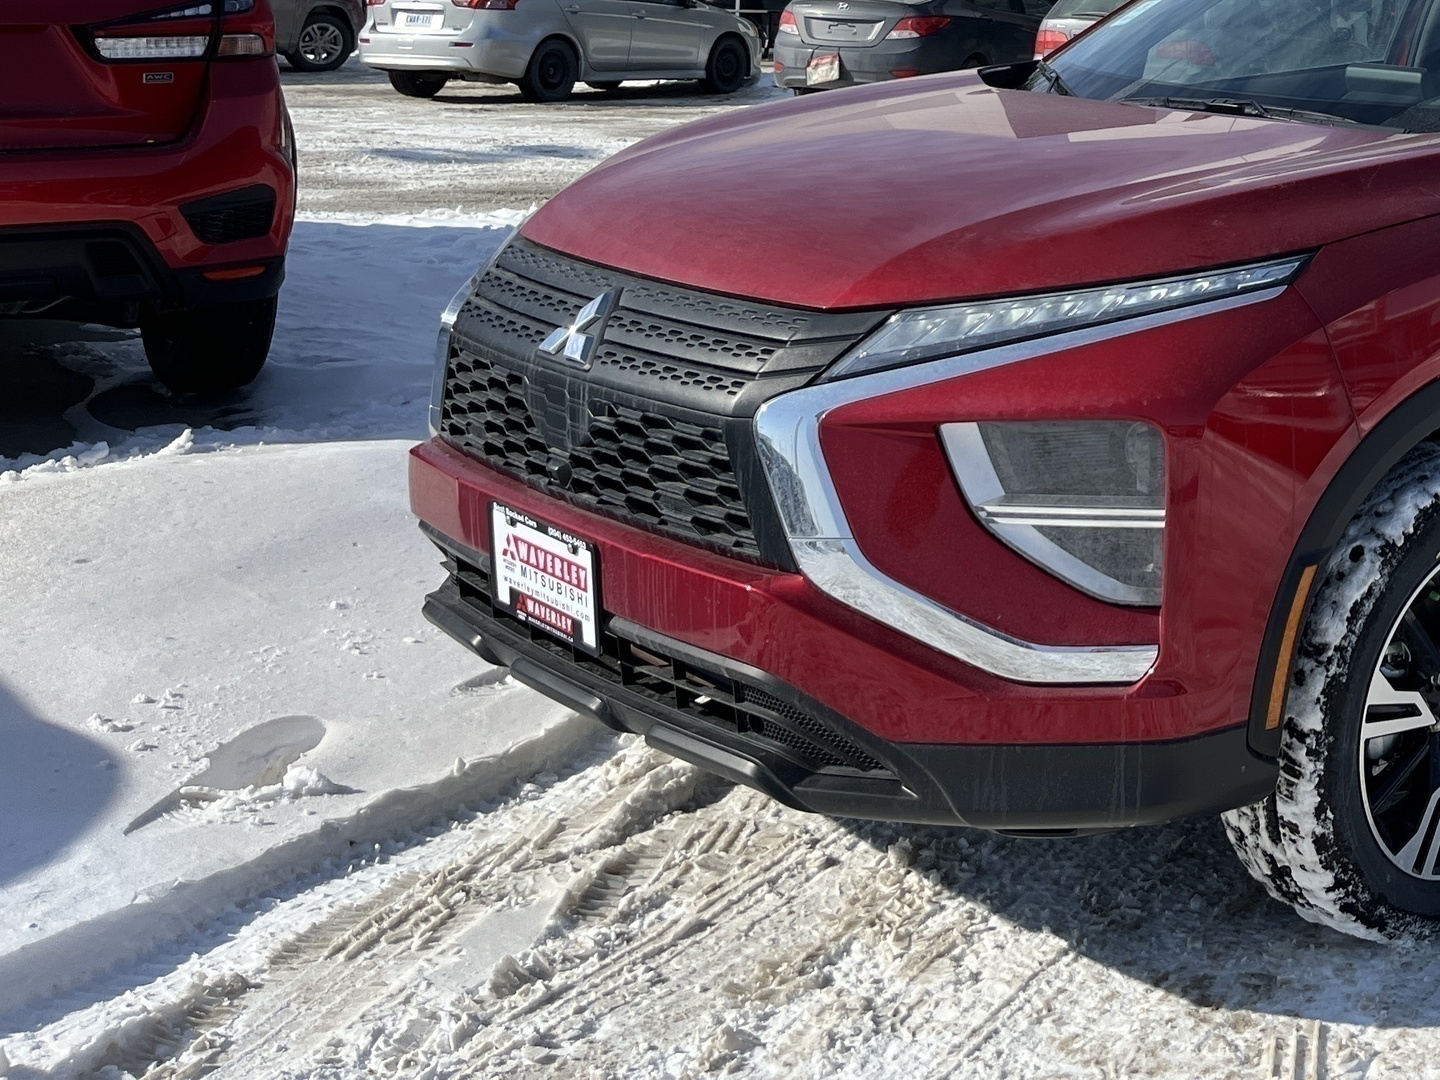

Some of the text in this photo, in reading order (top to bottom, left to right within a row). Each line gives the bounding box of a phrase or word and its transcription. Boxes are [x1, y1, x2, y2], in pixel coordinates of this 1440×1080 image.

[517, 540, 588, 590] WAVERLEY
[520, 564, 588, 609] MITSUBISHI
[526, 597, 573, 632] WAVERLEY
